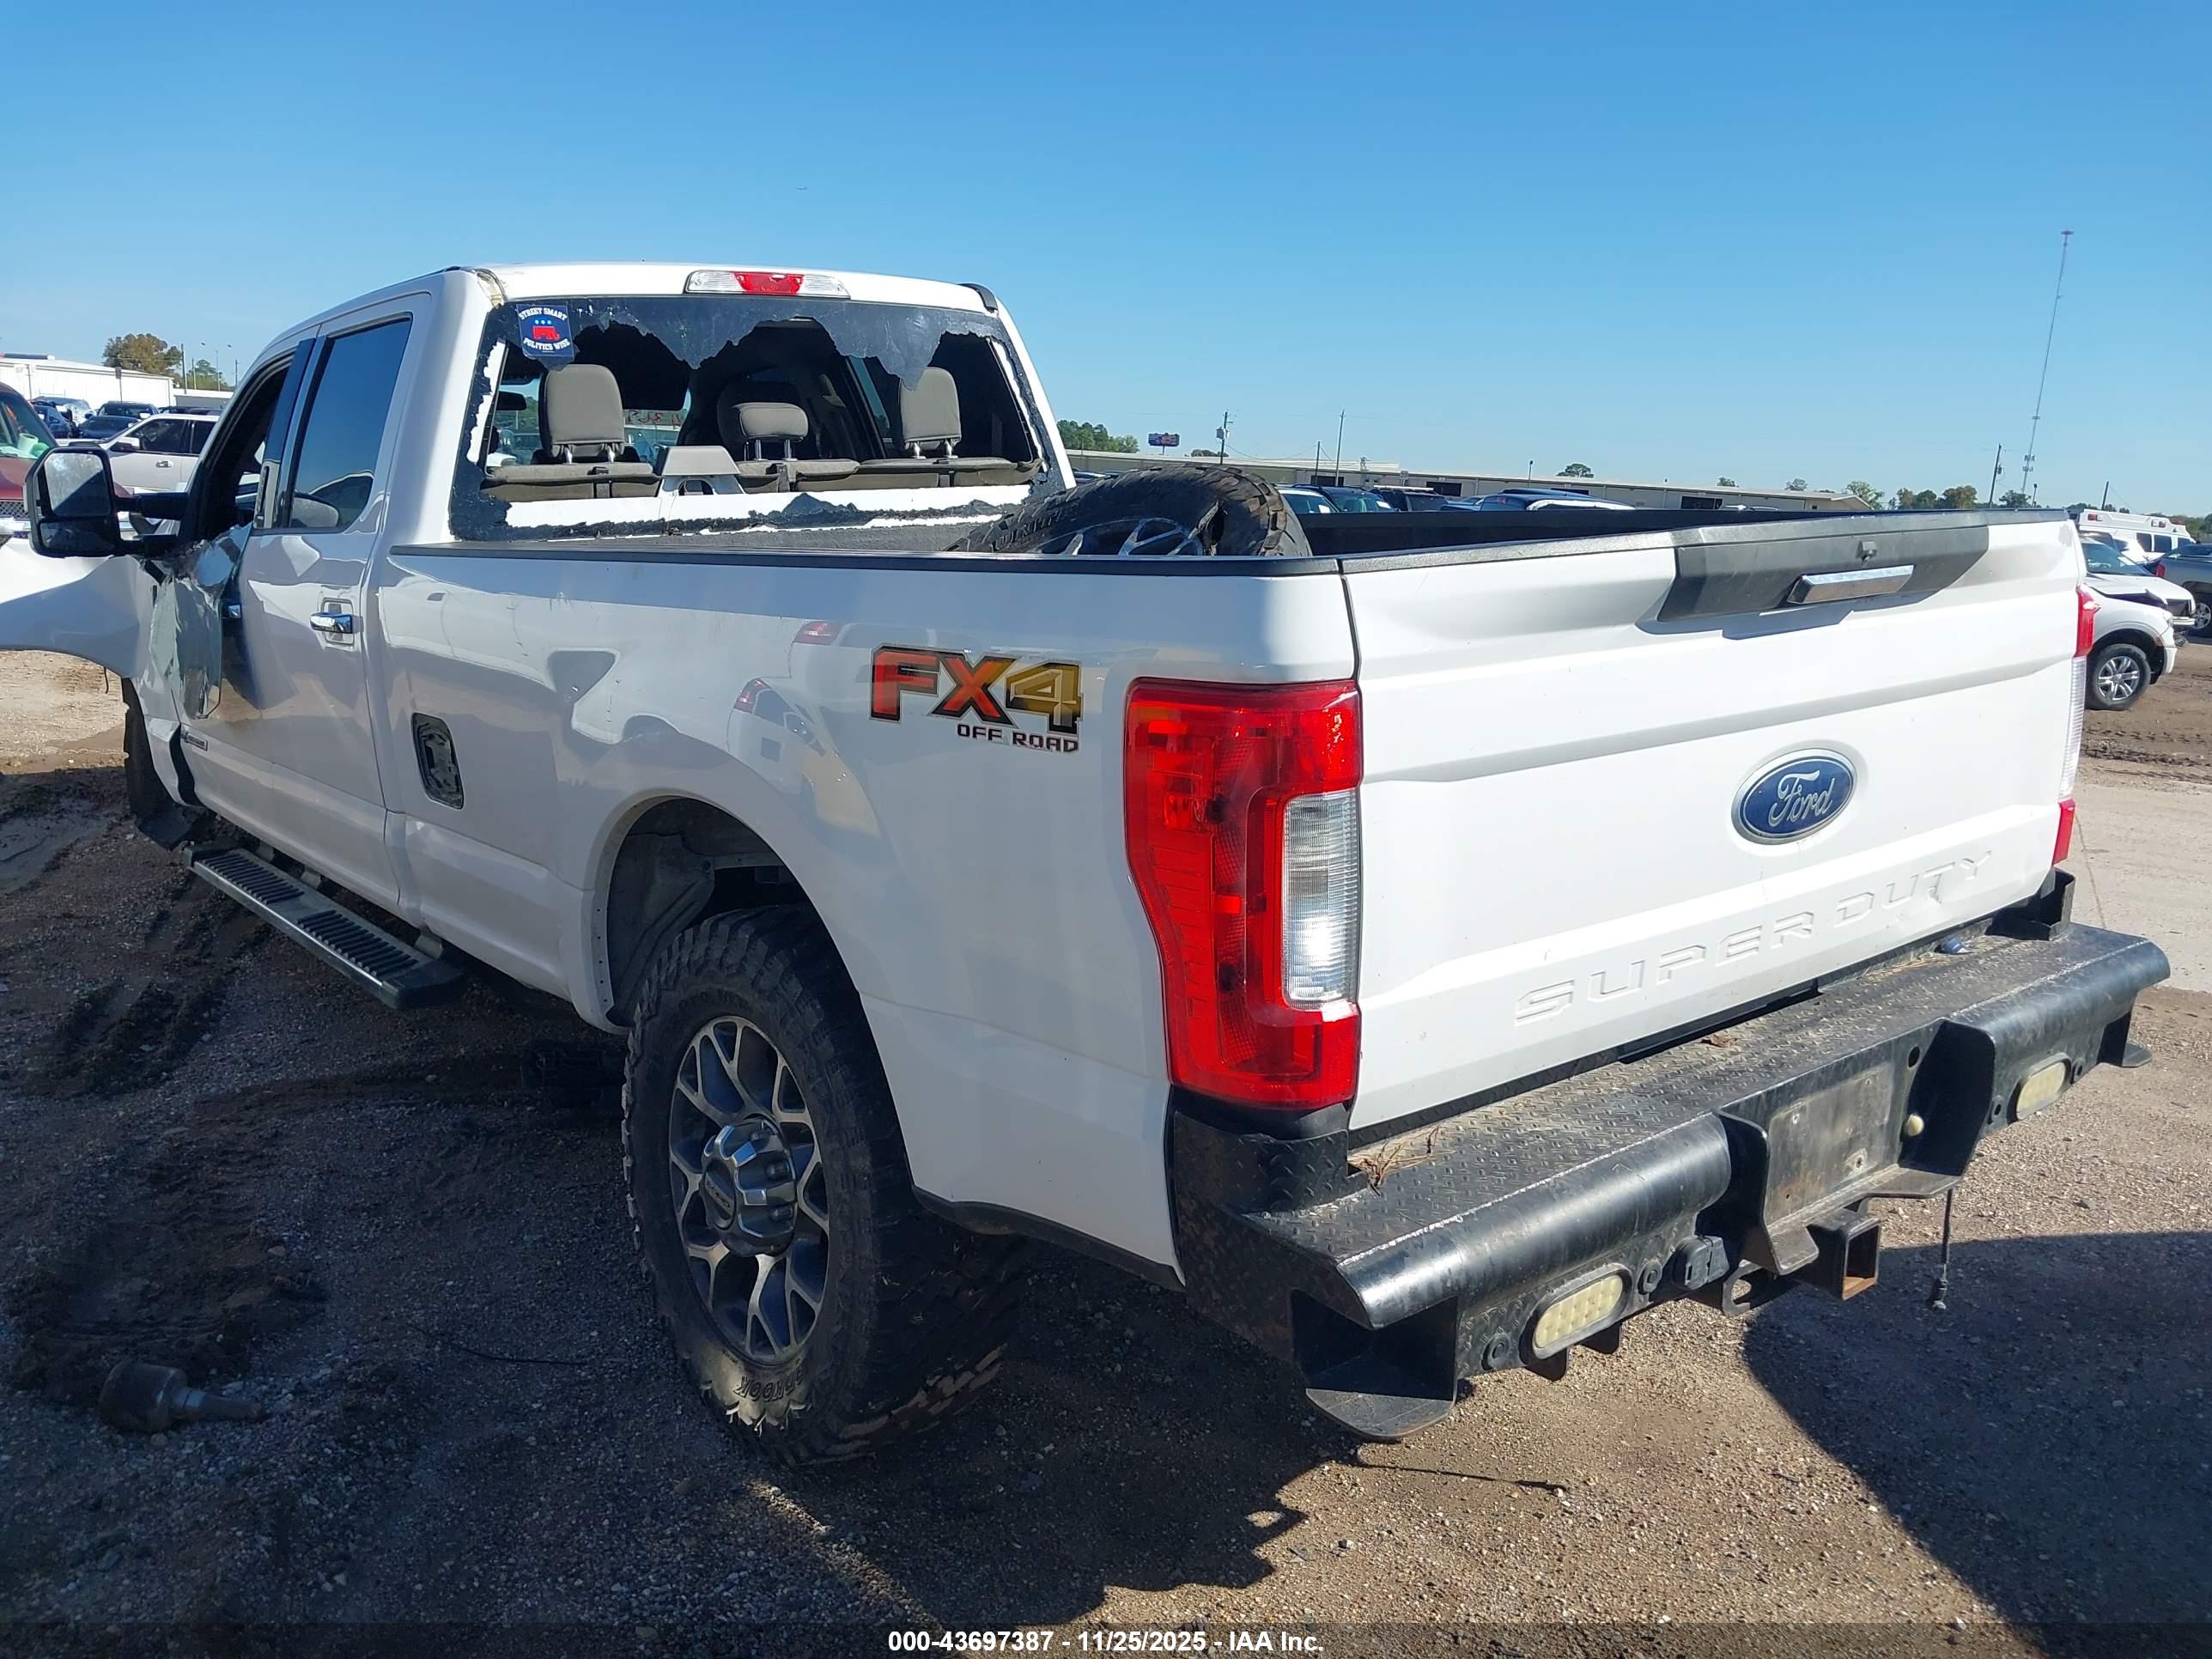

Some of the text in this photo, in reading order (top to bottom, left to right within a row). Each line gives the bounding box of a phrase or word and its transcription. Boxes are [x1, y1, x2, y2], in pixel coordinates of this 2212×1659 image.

[519, 307, 568, 321] STREET SMART
[523, 337, 571, 351] POLITICS WISE
[869, 644, 1084, 736] FX4
[957, 724, 1079, 753] OFF ROAD
[1768, 770, 1836, 828] Ford
[1515, 850, 1992, 1027] SUPER DUTY
